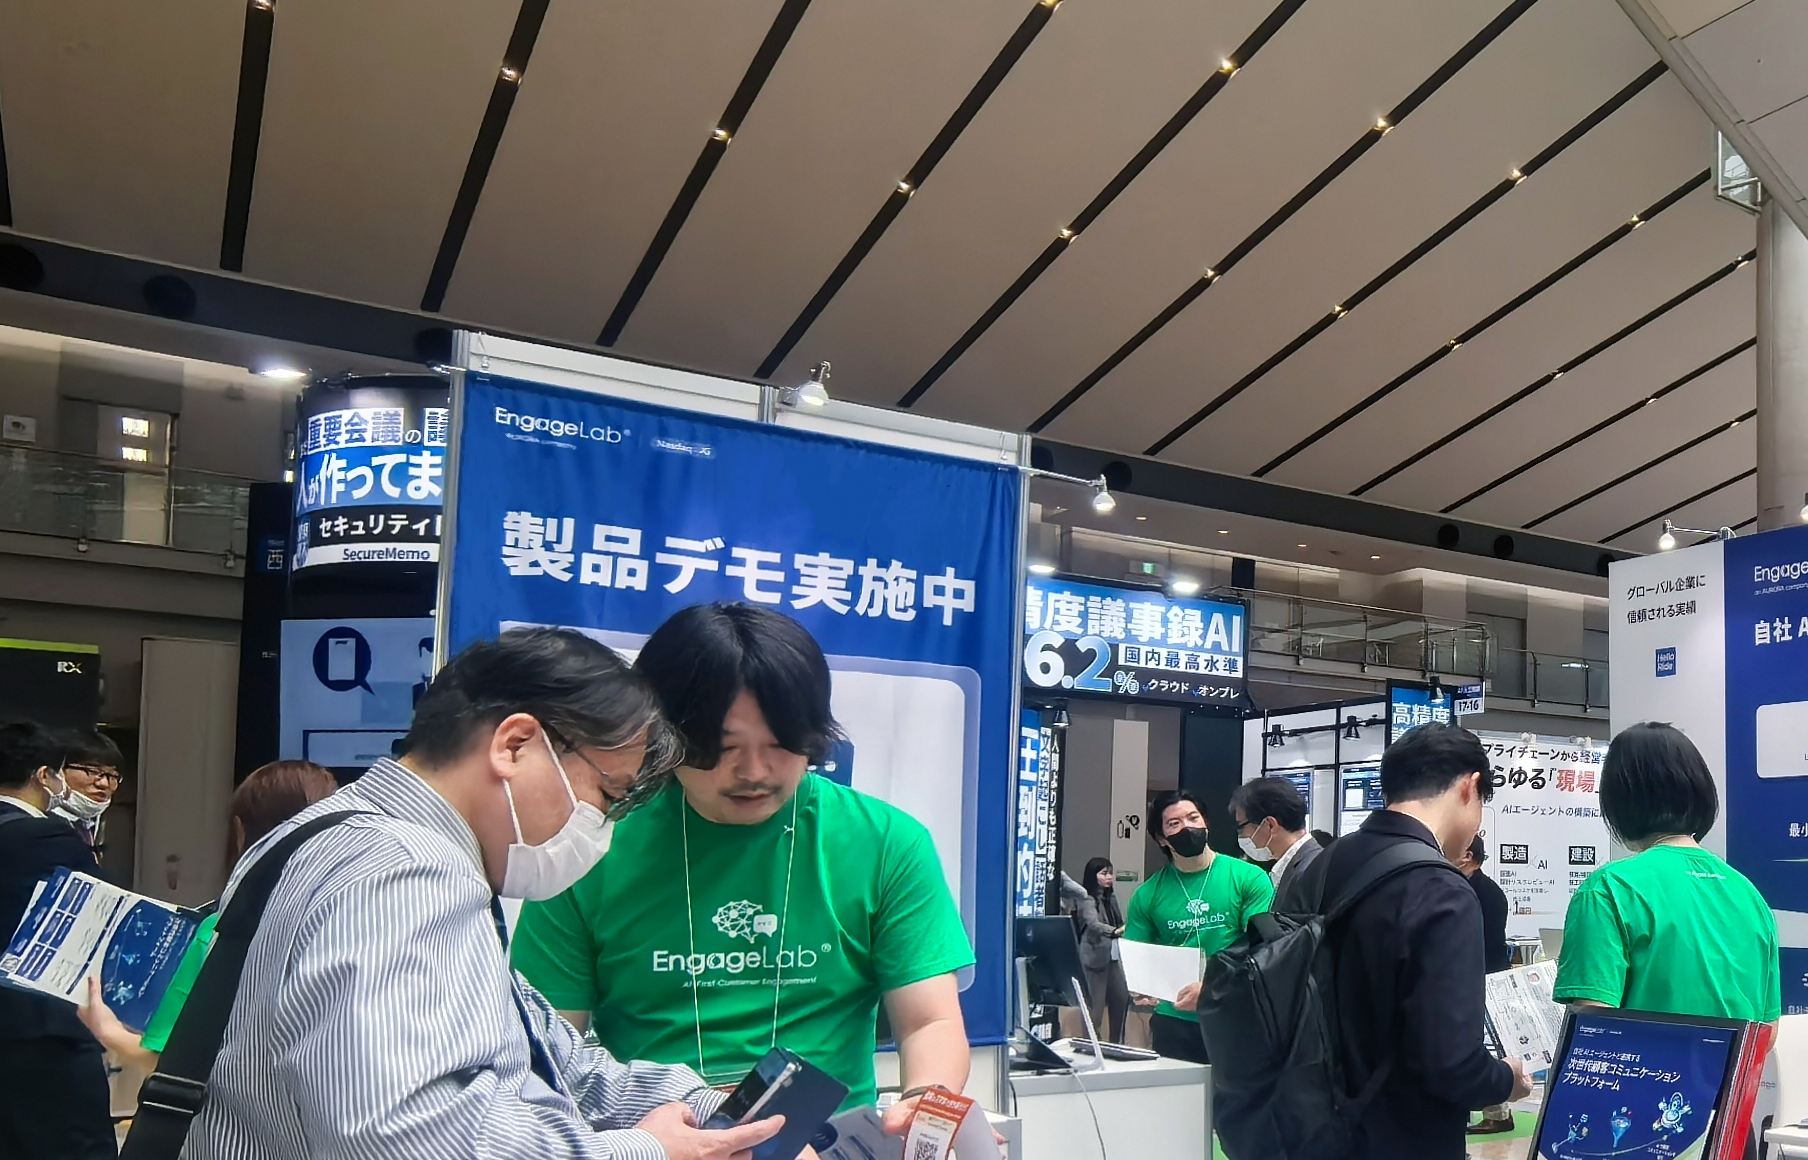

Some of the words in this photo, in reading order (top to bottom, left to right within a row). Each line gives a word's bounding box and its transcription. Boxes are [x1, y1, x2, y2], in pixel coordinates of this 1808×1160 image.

[343, 547, 430, 560] SecureMemo
[501, 511, 976, 627] 製品デモ実施中
[1627, 574, 1706, 600] グローバル企業に
[1627, 600, 1697, 624] 信頼される実績
[57, 661, 82, 674] RX
[1124, 646, 1239, 675] 国内最高水準
[1149, 679, 1189, 694] クラウド
[1502, 804, 1603, 818] AIエージェントの構築に
[1537, 860, 1548, 870] AI
